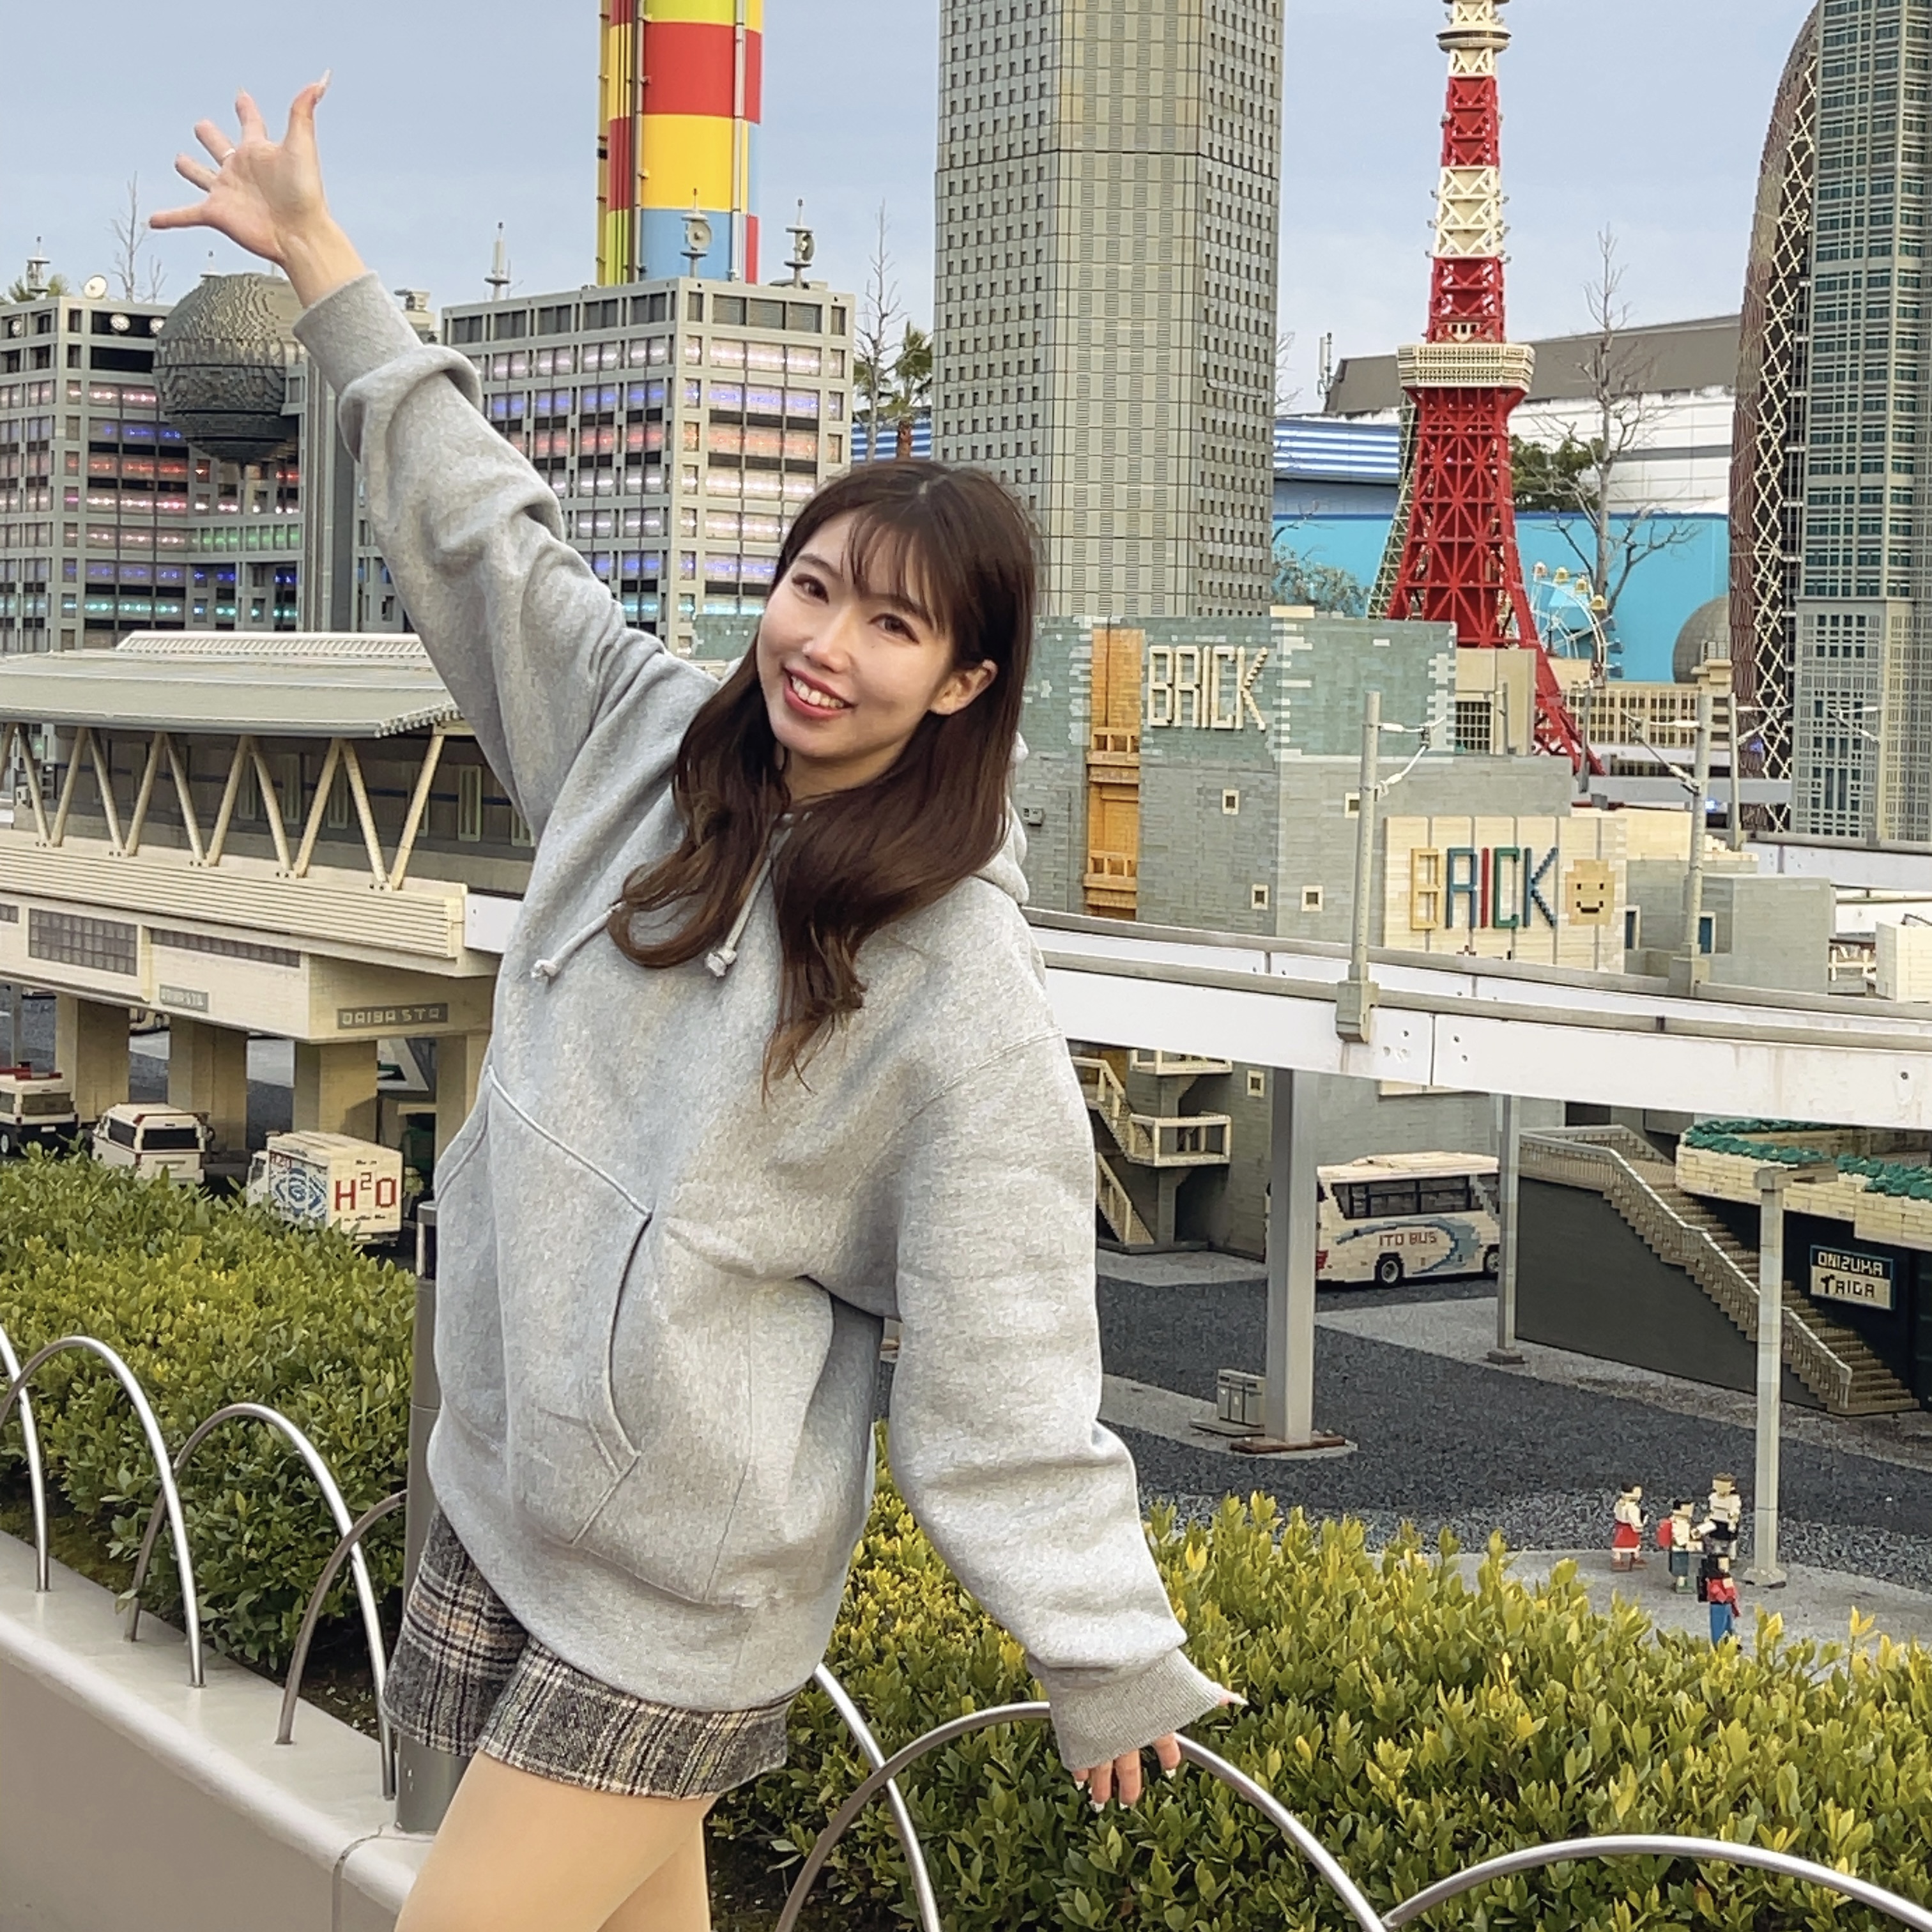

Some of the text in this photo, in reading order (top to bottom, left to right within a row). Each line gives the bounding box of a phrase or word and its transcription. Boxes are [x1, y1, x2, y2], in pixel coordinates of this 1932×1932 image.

[1147, 645, 1268, 731] BRICK
[1411, 847, 1559, 931] BRICK
[1379, 1232, 1436, 1246] ITO BUS
[1818, 1252, 1883, 1276] ONIZUKA
[1820, 1274, 1875, 1298] TAIGA
